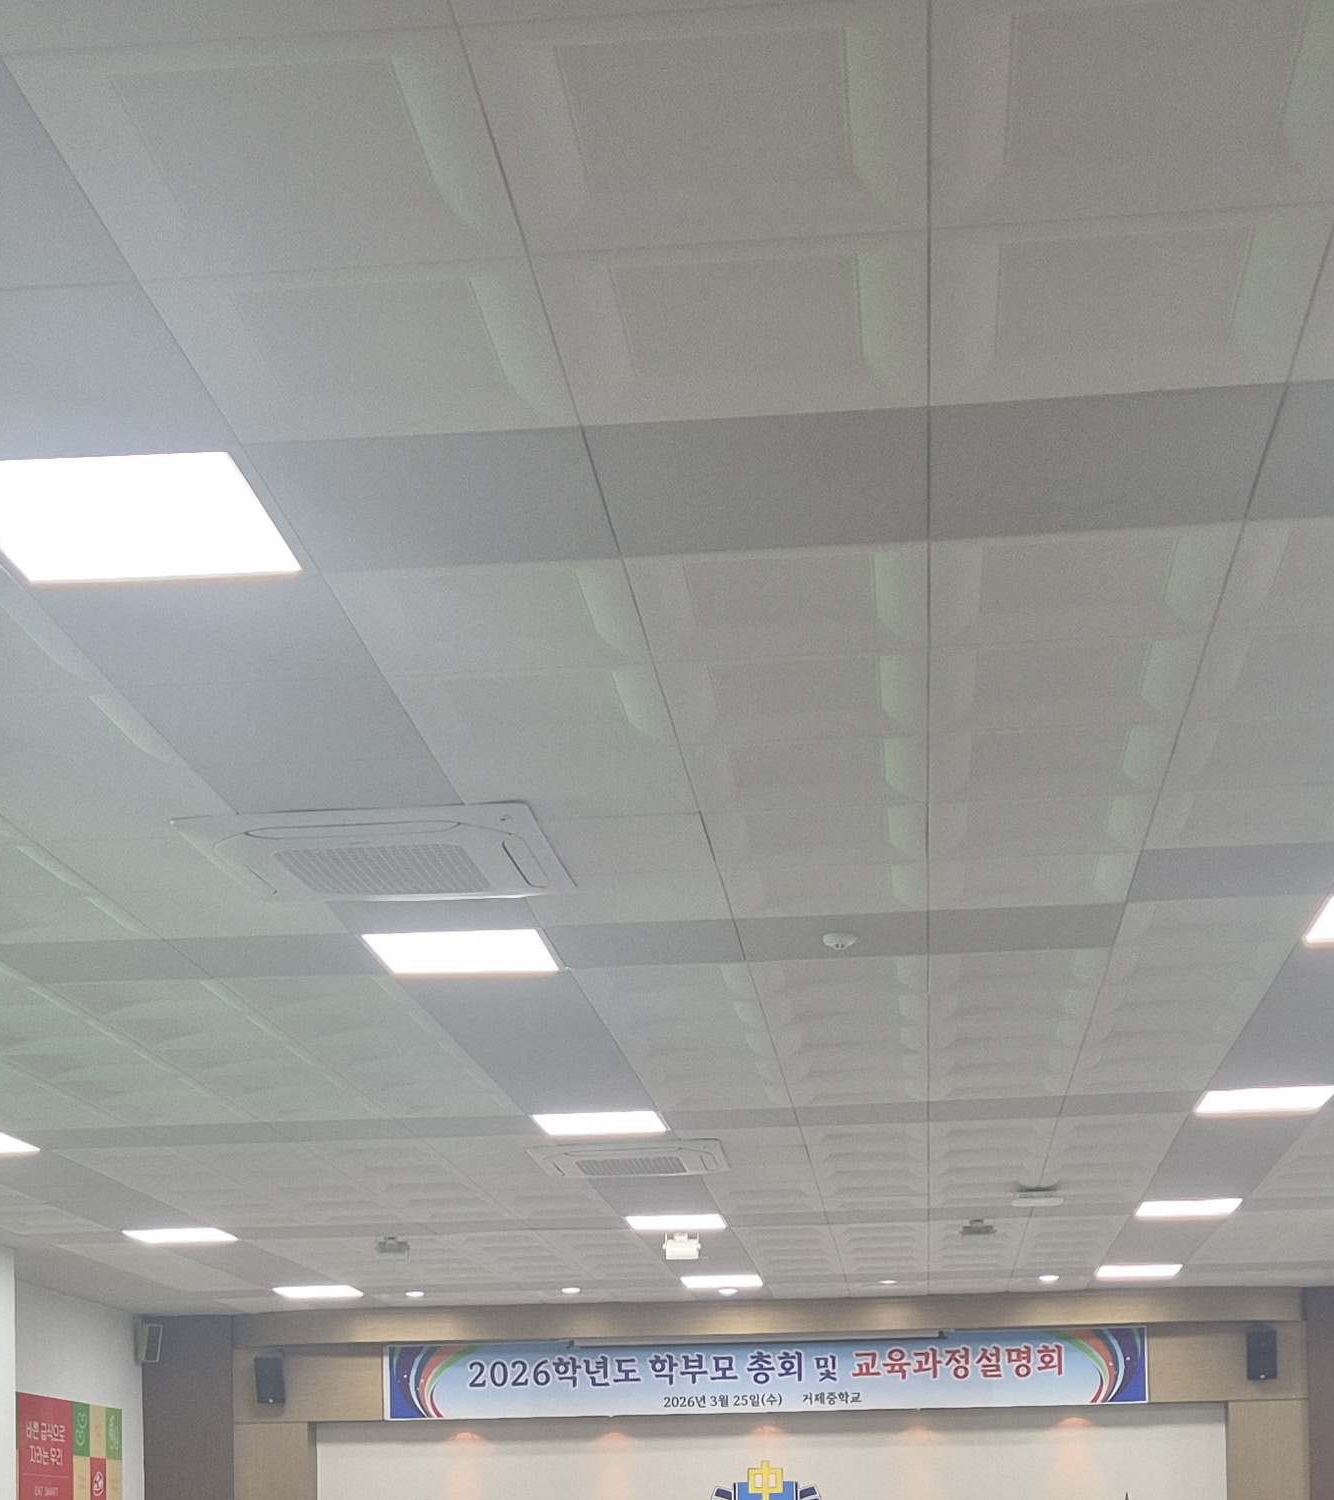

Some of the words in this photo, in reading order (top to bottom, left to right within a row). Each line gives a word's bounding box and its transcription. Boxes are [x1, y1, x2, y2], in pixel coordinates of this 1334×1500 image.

[467, 1354, 642, 1389] 2026학년도
[648, 1351, 739, 1386] 학부모
[746, 1350, 804, 1385] 총회
[814, 1354, 838, 1383] 및
[663, 1395, 707, 1408] 2026년
[710, 1394, 730, 1407] 3월
[732, 1393, 783, 1408] 25일(수)
[802, 1391, 862, 1405] 거제중학교
[29, 1445, 49, 1466] 자라는
[50, 1447, 63, 1466] 우리
